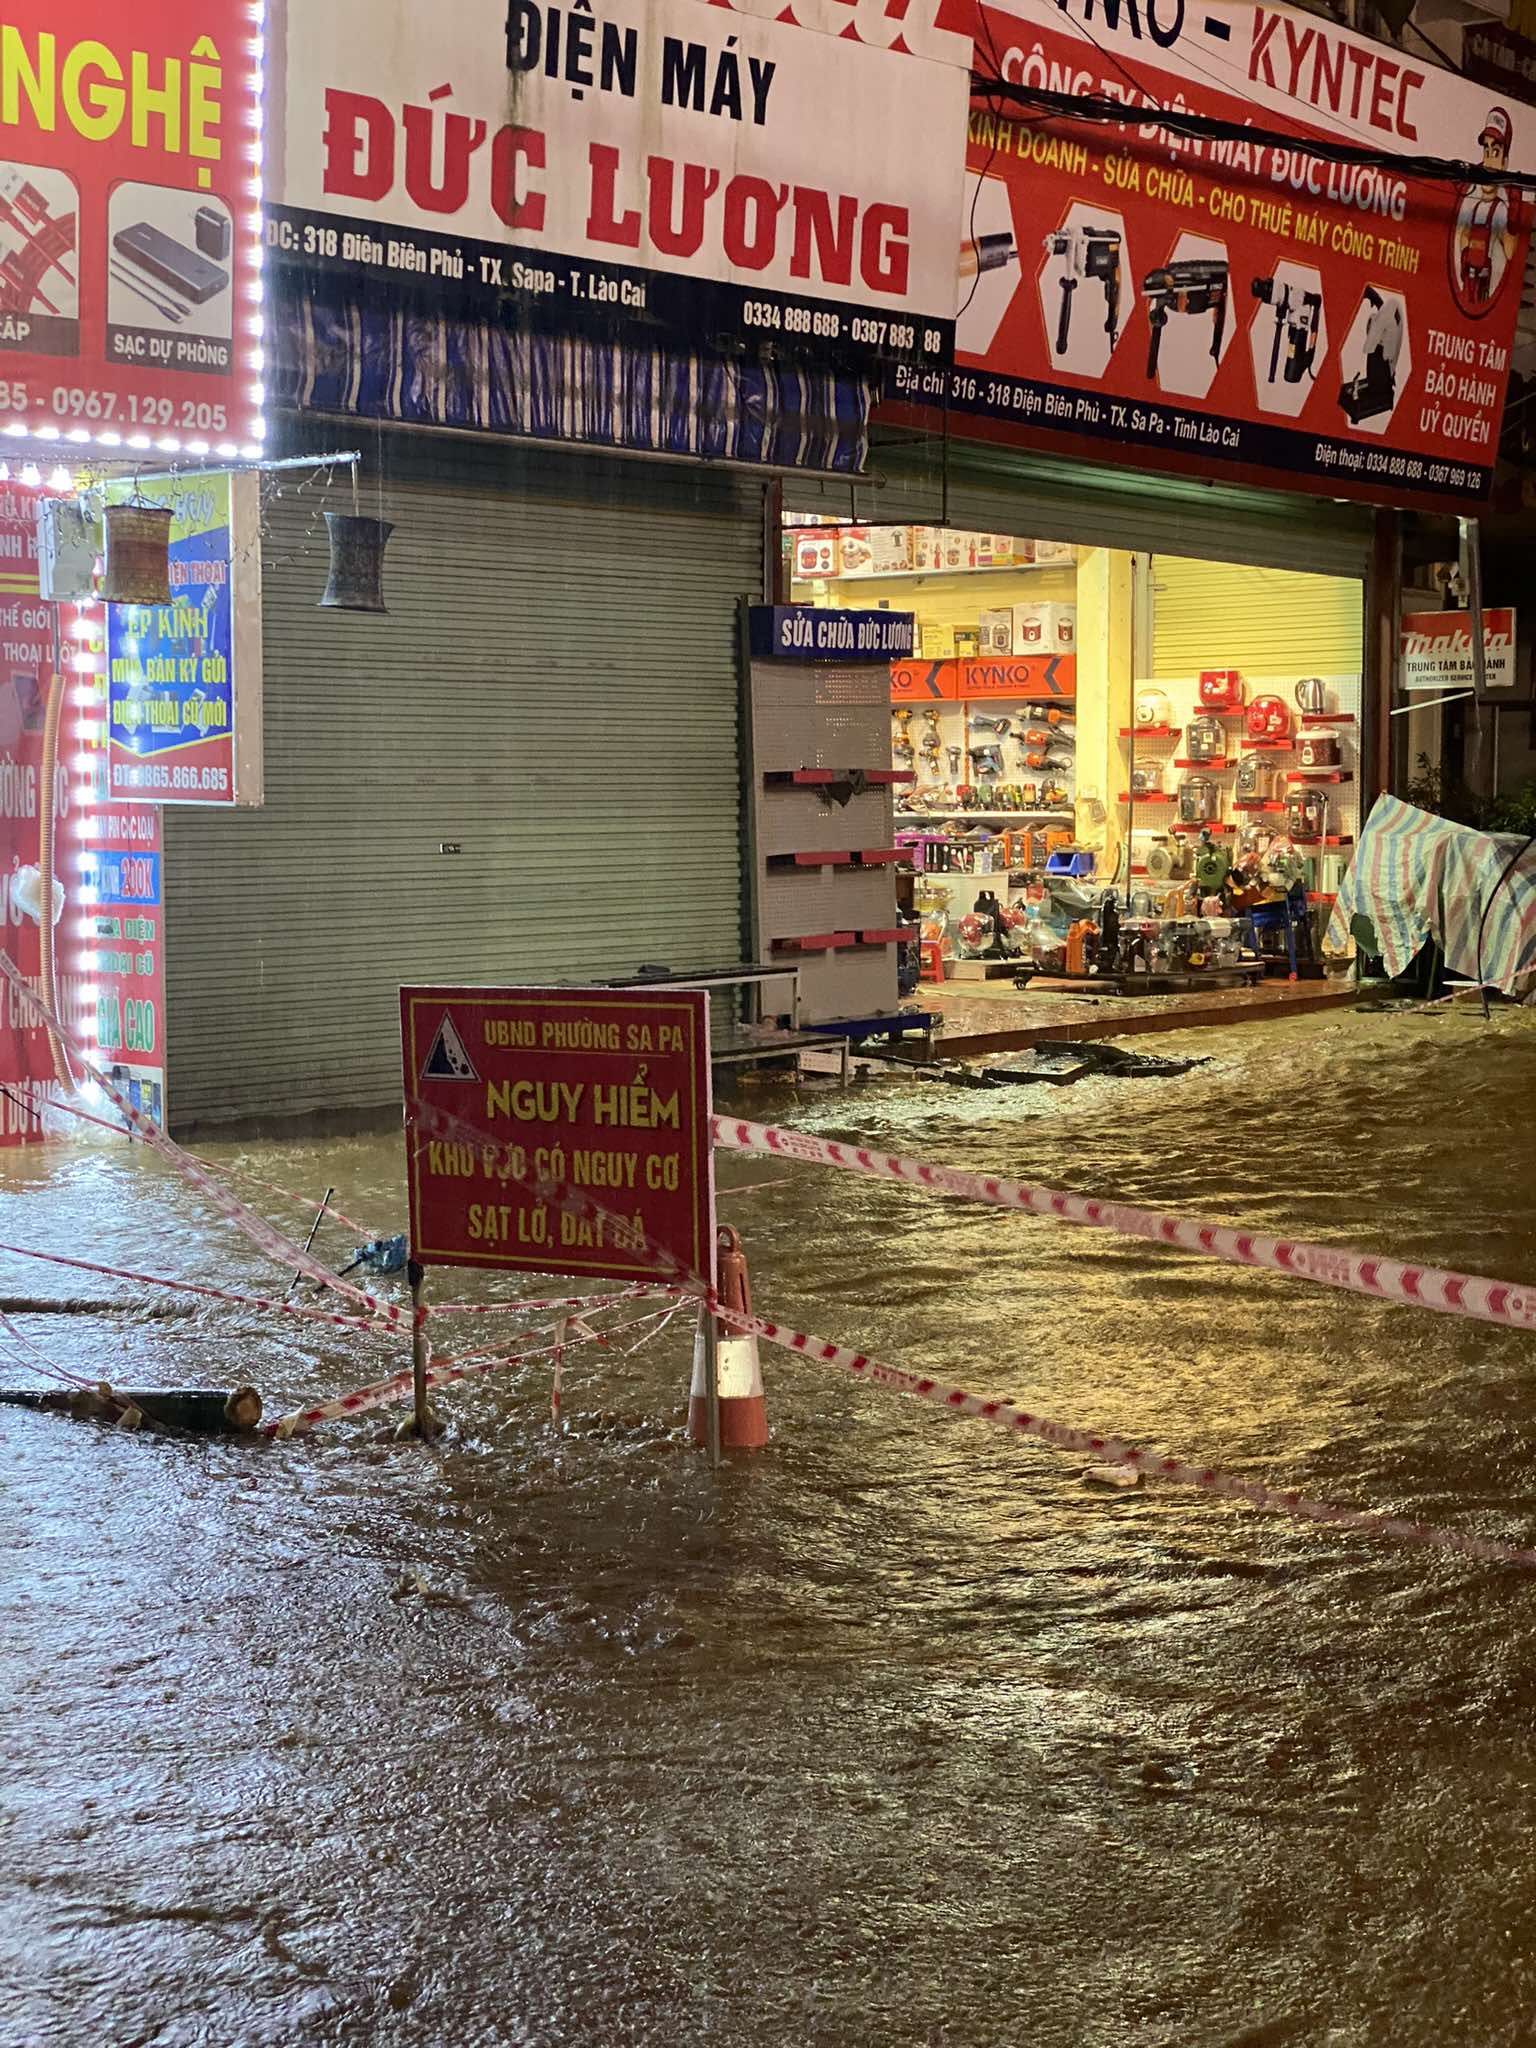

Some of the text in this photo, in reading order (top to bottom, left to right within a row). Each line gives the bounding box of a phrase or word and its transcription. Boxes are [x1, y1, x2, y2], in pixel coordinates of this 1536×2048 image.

[505, 0, 638, 101] ĐIỆN
[661, 35, 777, 126] MÁY
[1247, 6, 1426, 142] KYNTEC
[1, 24, 223, 189] NGHỆ
[322, 82, 910, 297] ĐỨC LƯƠNG
[1017, 127, 1088, 176] DOANH
[1103, 146, 1141, 193] SỬA
[1147, 166, 1194, 208] CHỮA
[1208, 186, 1247, 223] CHO
[1250, 198, 1293, 237] THUÊ
[1294, 210, 1329, 248] MÁY
[1331, 220, 1375, 261] CÔNG
[1377, 236, 1421, 275] TRÌNH
[1327, 162, 1408, 222] LƯƠNG
[303, 225, 338, 258] 318
[387, 239, 427, 273] Biên
[429, 247, 464, 280] Phủ
[511, 261, 556, 297] Sapa
[569, 270, 586, 299] T.
[588, 274, 618, 302] Lào
[620, 278, 647, 308] Cai
[0, 315, 31, 341] ÁP
[743, 300, 782, 330] 0334
[784, 306, 811, 334] 888
[812, 312, 840, 338] 688
[851, 317, 887, 345] 0387
[889, 323, 914, 350] 883
[113, 333, 229, 366] SẠC DỰ PHÒNG
[1426, 329, 1507, 372] TRUNG TÂM
[896, 364, 919, 395] Địa
[951, 376, 976, 401] 316
[986, 382, 1010, 407] 318
[1012, 387, 1042, 417] Điện
[1044, 392, 1073, 418] Biên
[1075, 396, 1100, 424] Phủ
[1110, 404, 1129, 429] TX.
[1131, 408, 1147, 431] Sa
[1148, 410, 1164, 435] Pa
[1199, 421, 1220, 445] Lào
[1222, 426, 1241, 448] Cai
[1424, 362, 1497, 407] BẢO HÀNH
[51, 385, 228, 432] 0967.129.205
[1419, 401, 1491, 444] UỶ QUYỀN
[1315, 442, 1338, 468] Điện
[1338, 449, 1366, 473] thoại:
[781, 610, 814, 648] SỬA
[817, 615, 855, 649] CHỮA
[857, 616, 881, 650] ĐỨC
[881, 621, 912, 650] LƯƠNG
[3, 642, 43, 668] THOẠI
[965, 664, 1030, 686] KYNKO
[1407, 661, 1436, 673] TRUNG
[120, 857, 155, 899] 200K
[125, 998, 155, 1053] CAO
[484, 1017, 684, 1052] UBND PHƯỜNG SA PA
[486, 1063, 681, 1129] NGUY HIỂM
[428, 1140, 475, 1178] KHU
[533, 1141, 567, 1183] CÓ
[572, 1149, 639, 1189] NGUY
[645, 1152, 680, 1191] CƠ
[468, 1204, 512, 1247] SẠT
